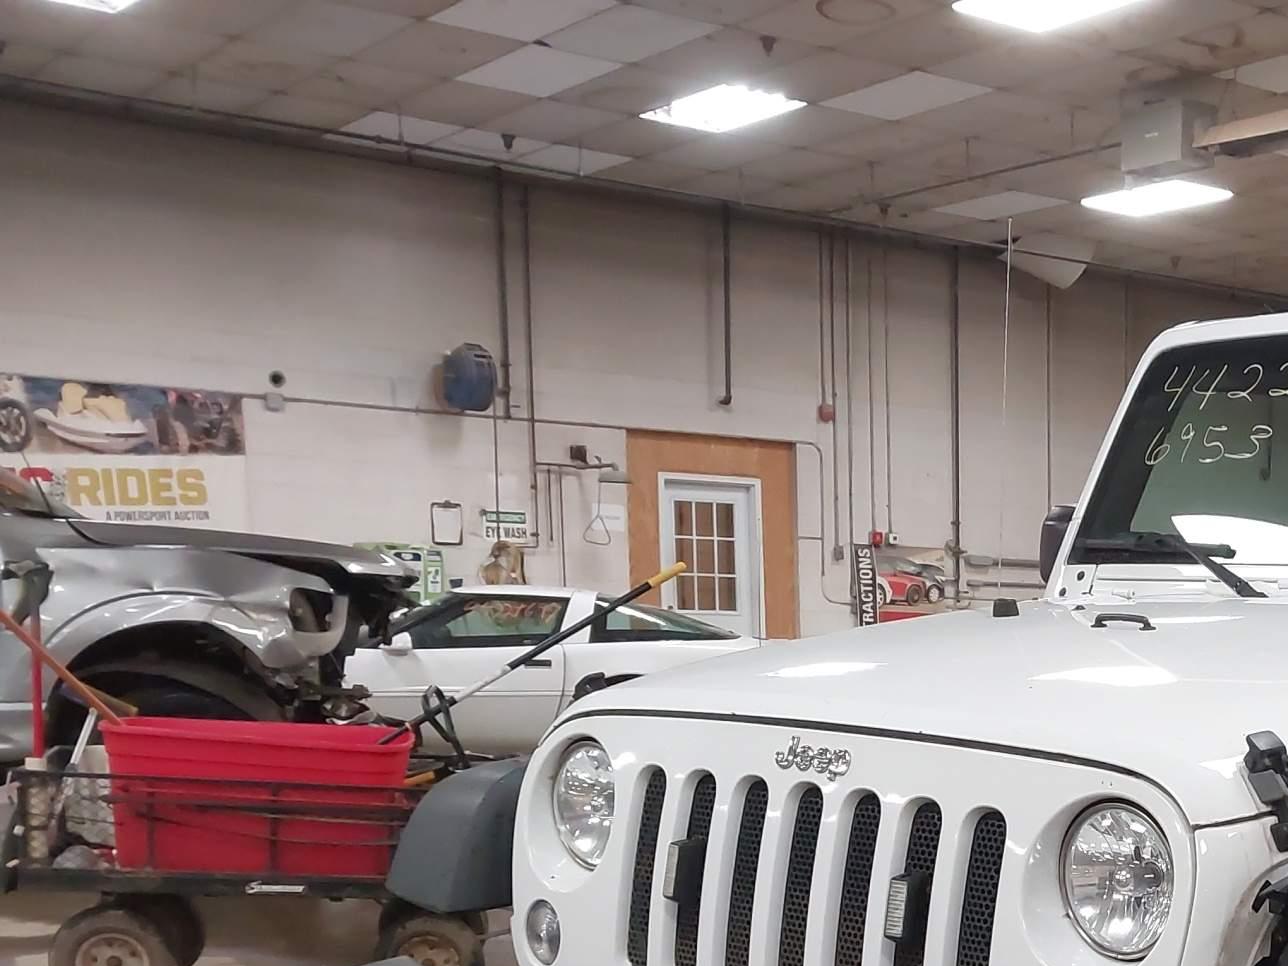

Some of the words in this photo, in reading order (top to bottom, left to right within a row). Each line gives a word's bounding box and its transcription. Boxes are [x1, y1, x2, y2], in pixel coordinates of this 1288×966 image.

[1145, 423, 1273, 465] 6953
[66, 468, 208, 506] RIDES
[106, 511, 112, 521] A
[114, 511, 171, 521] POWERSPORT
[175, 511, 210, 521] AUCTION
[775, 736, 851, 782] Jeep
